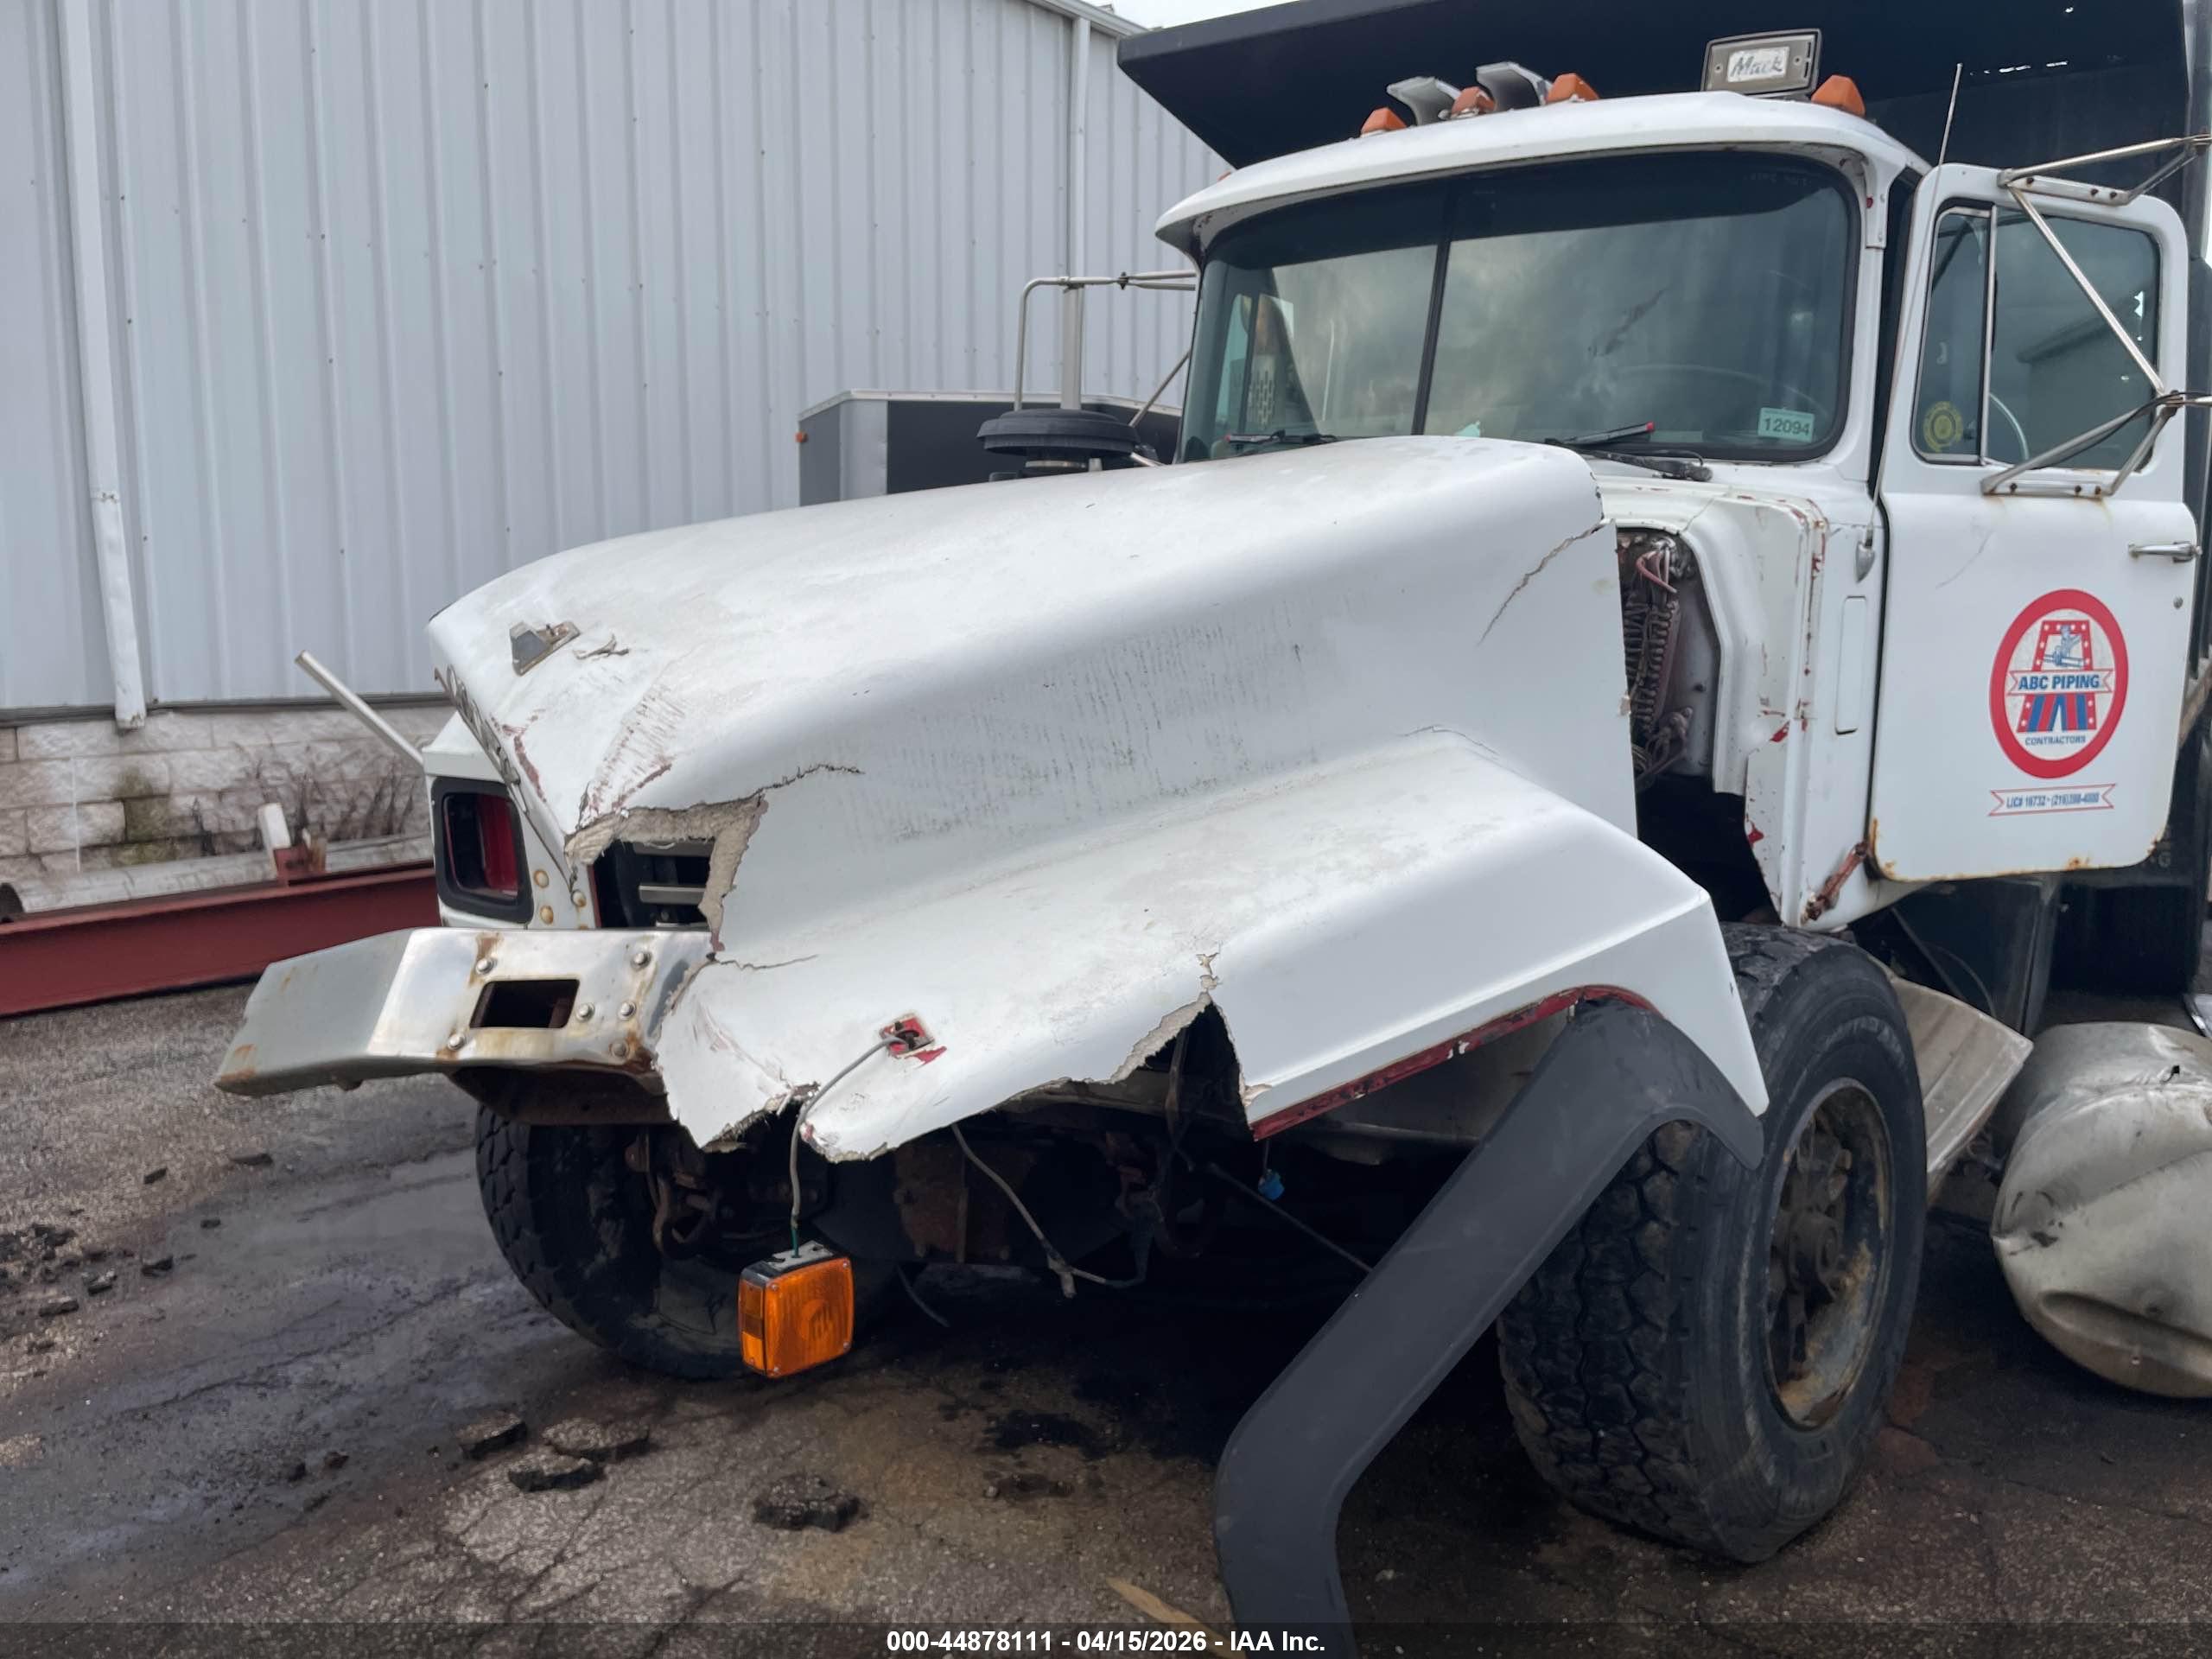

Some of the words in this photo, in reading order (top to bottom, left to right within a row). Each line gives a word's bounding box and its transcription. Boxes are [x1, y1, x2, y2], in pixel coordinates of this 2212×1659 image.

[2018, 676, 2049, 690] ABC
[2051, 674, 2101, 690] PIPING
[2024, 735, 2087, 747] CONTRACTORS
